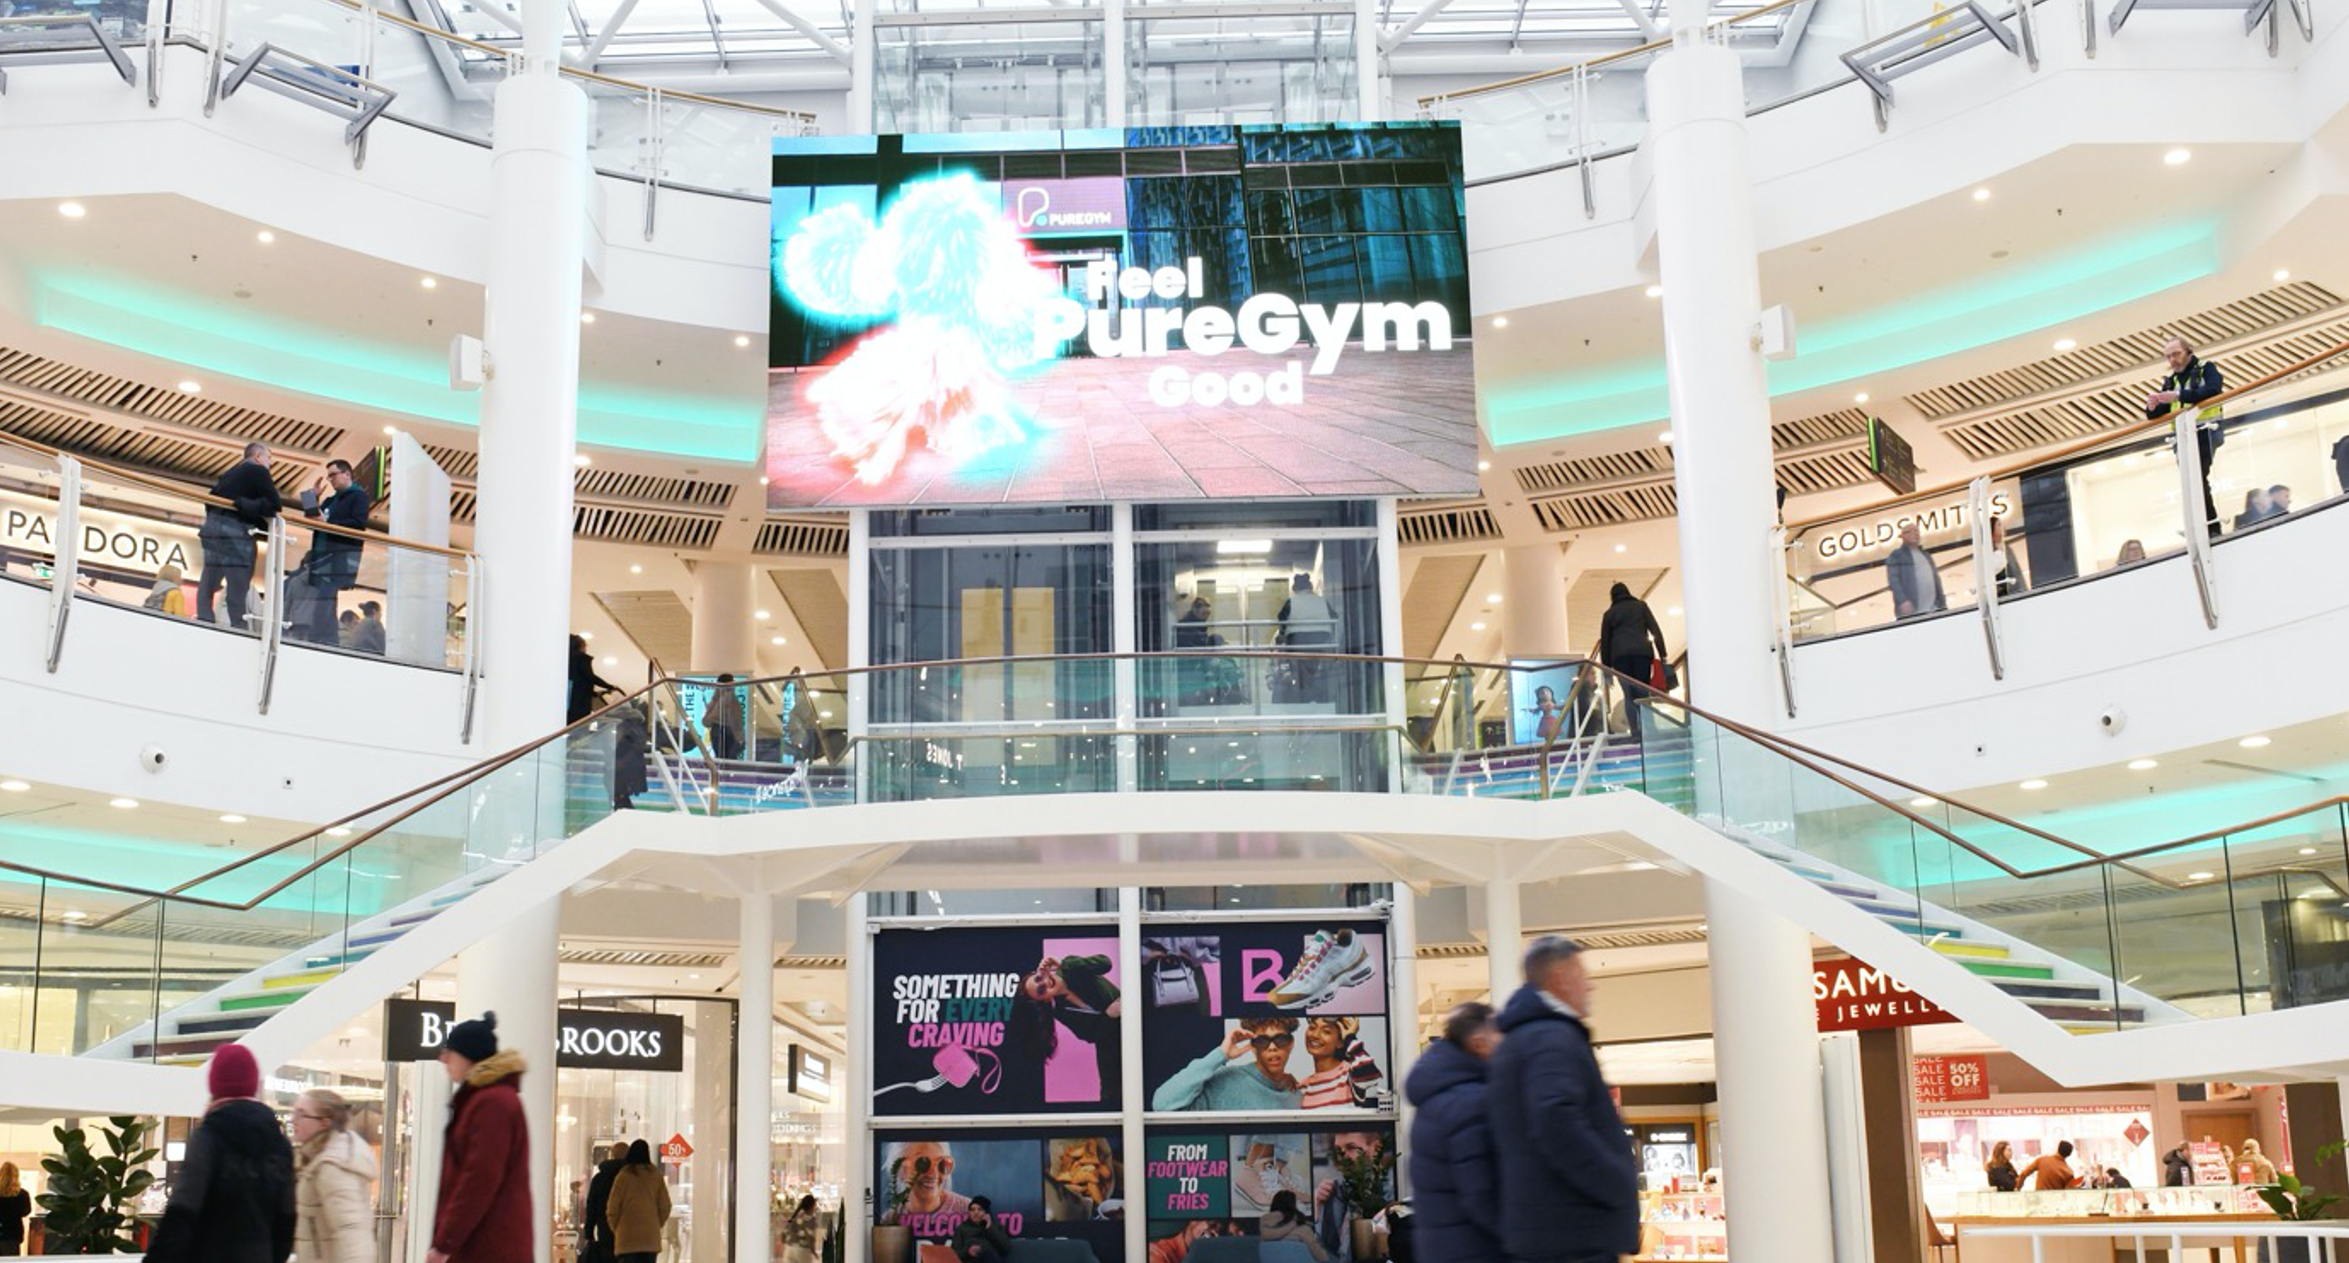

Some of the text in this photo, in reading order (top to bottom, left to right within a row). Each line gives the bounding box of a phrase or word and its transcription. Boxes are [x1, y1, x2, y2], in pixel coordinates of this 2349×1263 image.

[1049, 212, 1111, 227] PUREGYM
[1087, 256, 1203, 299] Feel
[1032, 293, 1452, 375] PureGym
[1148, 360, 1304, 408] Good
[7, 510, 189, 571] PADORA
[893, 973, 1020, 1000] SOMETHING
[896, 998, 1014, 1024] FOR EVERY
[1838, 999, 1946, 1023] JEWELL
[908, 1022, 1005, 1048] CRAVING
[1915, 1075, 1945, 1086] SALE
[1949, 1062, 1979, 1075] 50%
[1950, 1074, 1980, 1087] OFF
[1167, 1144, 1208, 1161] FROM
[1147, 1161, 1228, 1178] FOOTWEAR
[1179, 1177, 1198, 1194] TO
[1167, 1194, 1209, 1210] FRIES
[997, 1212, 1024, 1236] TO
